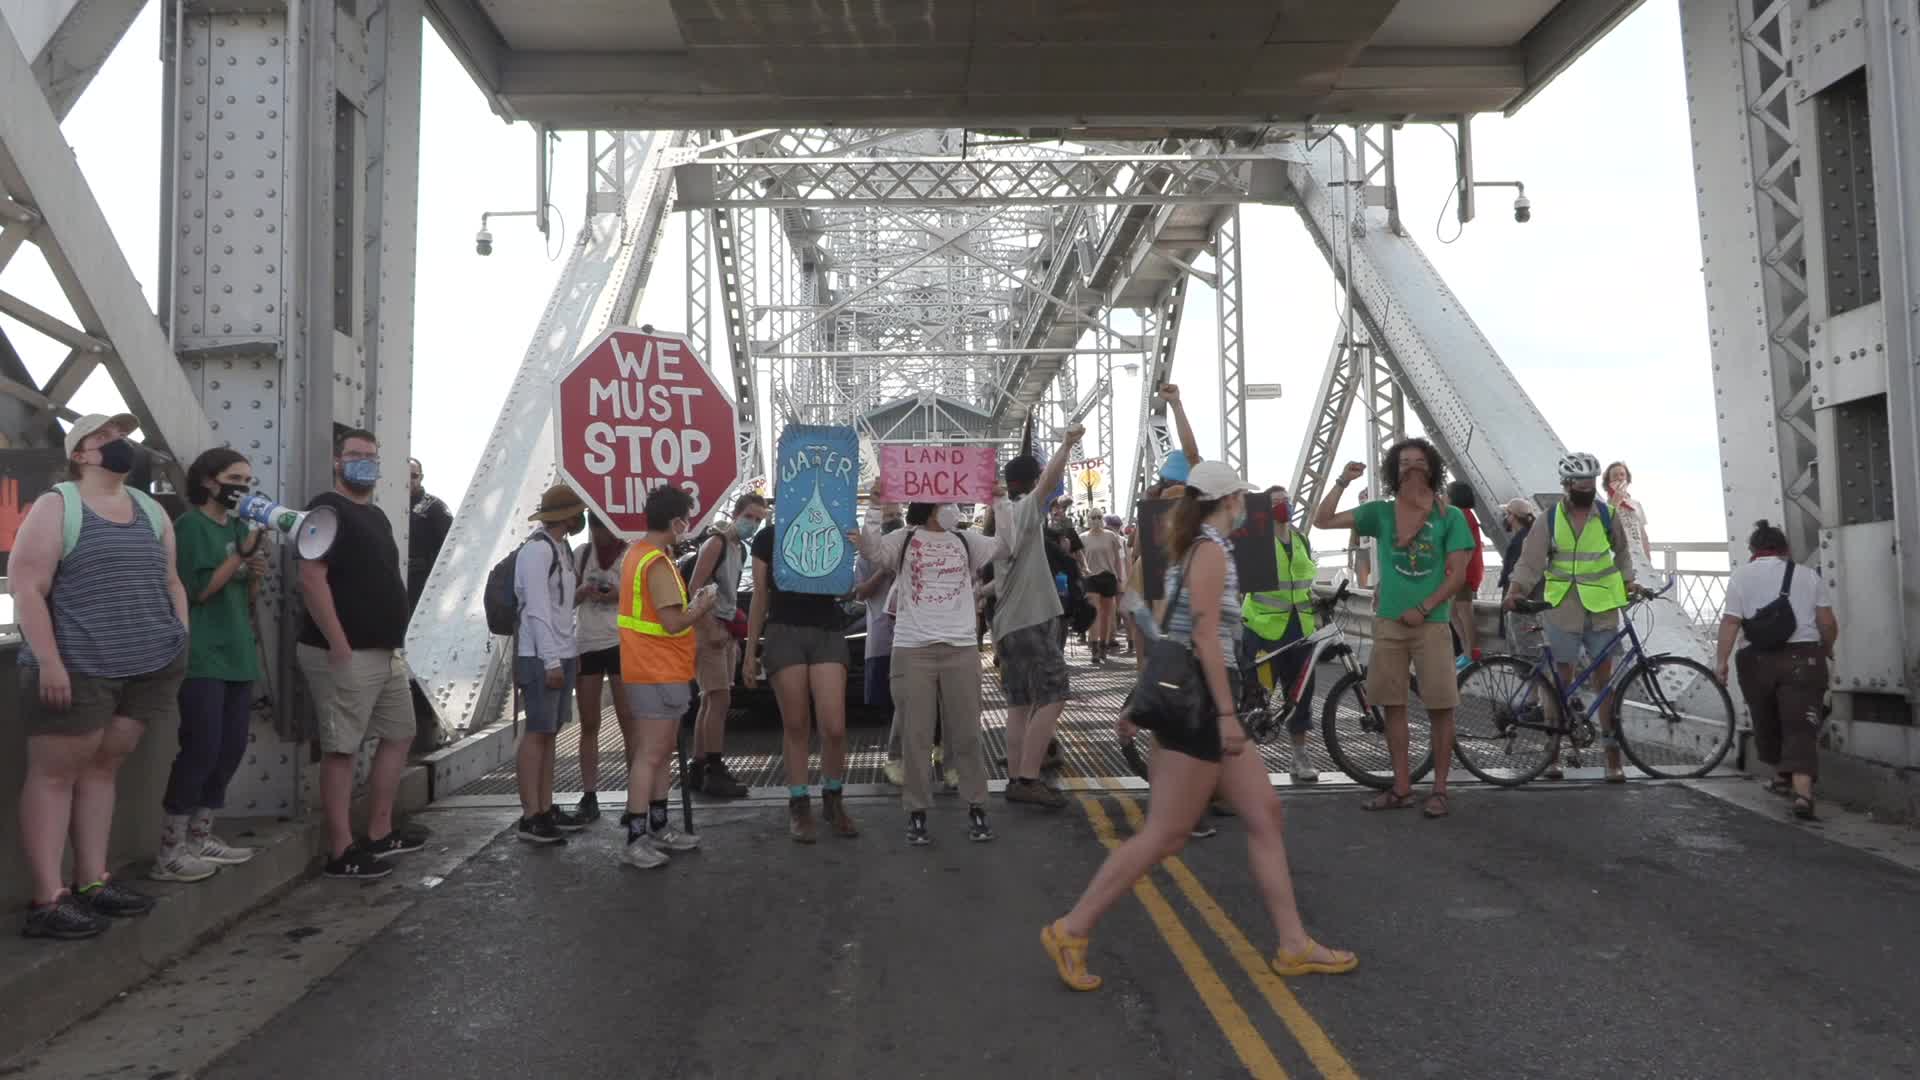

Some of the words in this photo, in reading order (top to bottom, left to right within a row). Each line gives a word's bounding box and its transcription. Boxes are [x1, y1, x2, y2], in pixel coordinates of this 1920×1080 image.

[609, 337, 683, 380] WE
[589, 377, 703, 425] MUST
[584, 421, 711, 477] STOP
[904, 448, 964, 465] LAND
[1071, 458, 1105, 471] STOP
[604, 476, 668, 514] LIN
[681, 480, 701, 518] 3
[903, 471, 969, 497] BACK
[784, 526, 838, 573] LIFE
